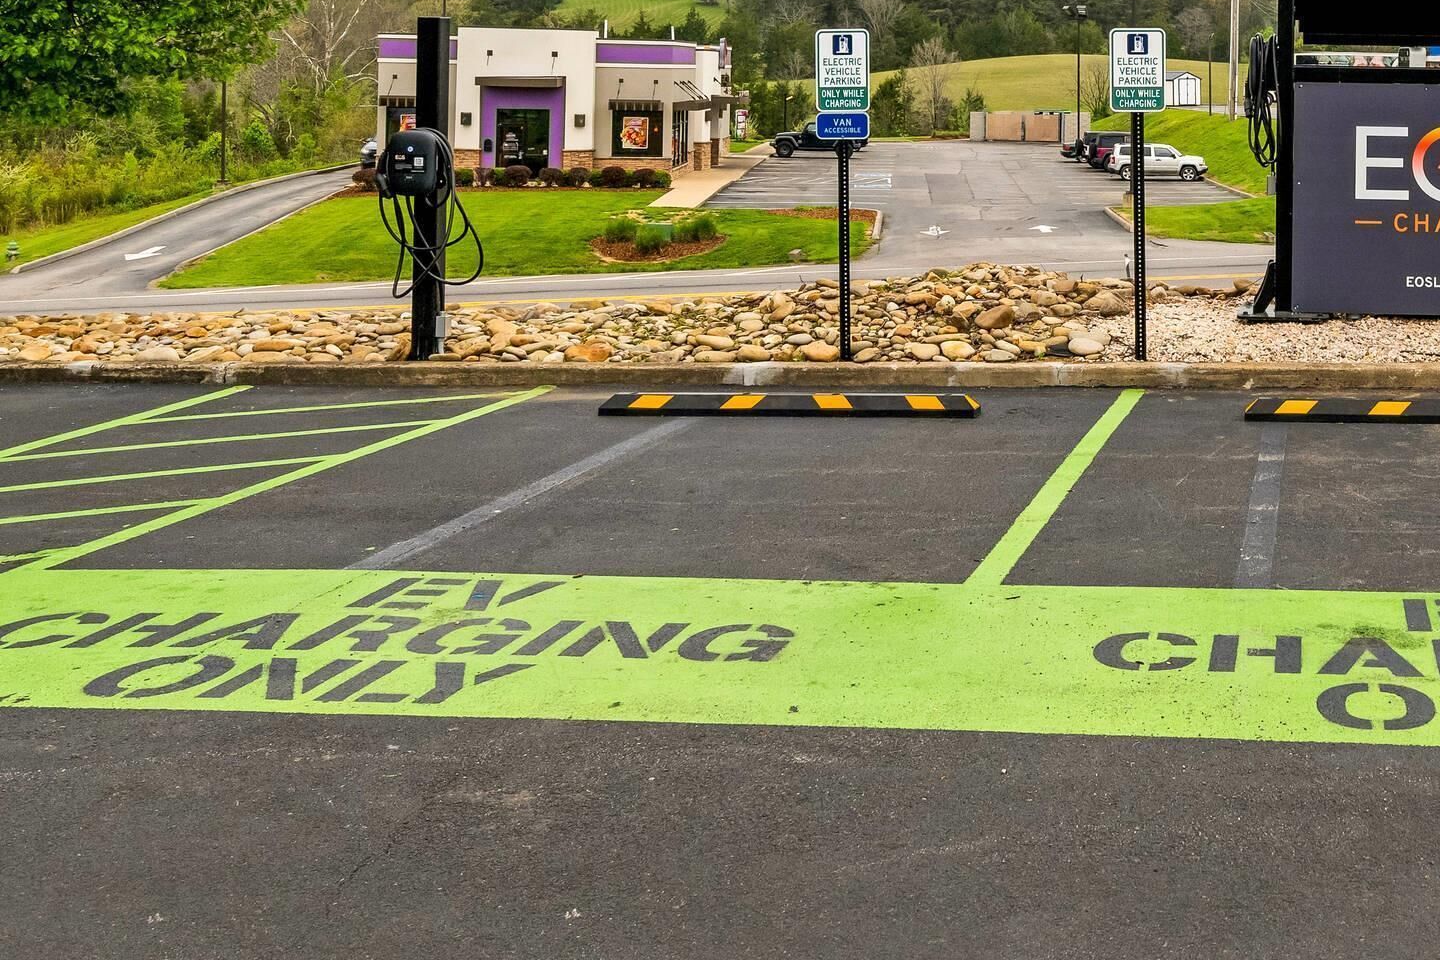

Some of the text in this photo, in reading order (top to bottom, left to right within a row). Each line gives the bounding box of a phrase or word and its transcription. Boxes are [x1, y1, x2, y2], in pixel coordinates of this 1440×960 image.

[823, 57, 863, 66] ELECTRIC
[1117, 57, 1159, 66] ELECTRIC
[824, 67, 861, 76] VEHICLE
[1119, 67, 1157, 76] VEHICLE
[824, 77, 862, 86] PARKING
[1118, 76, 1158, 85] PARKING
[821, 89, 865, 98] ONLY WHILE
[1115, 89, 1161, 98] ONLY WHILE
[824, 99, 862, 108] CHARGING
[1119, 99, 1157, 108] CHARGING
[832, 118, 852, 127] VAN
[346, 576, 567, 612] EV
[0, 611, 796, 663] CHARGING
[82, 653, 538, 705] ONLY
